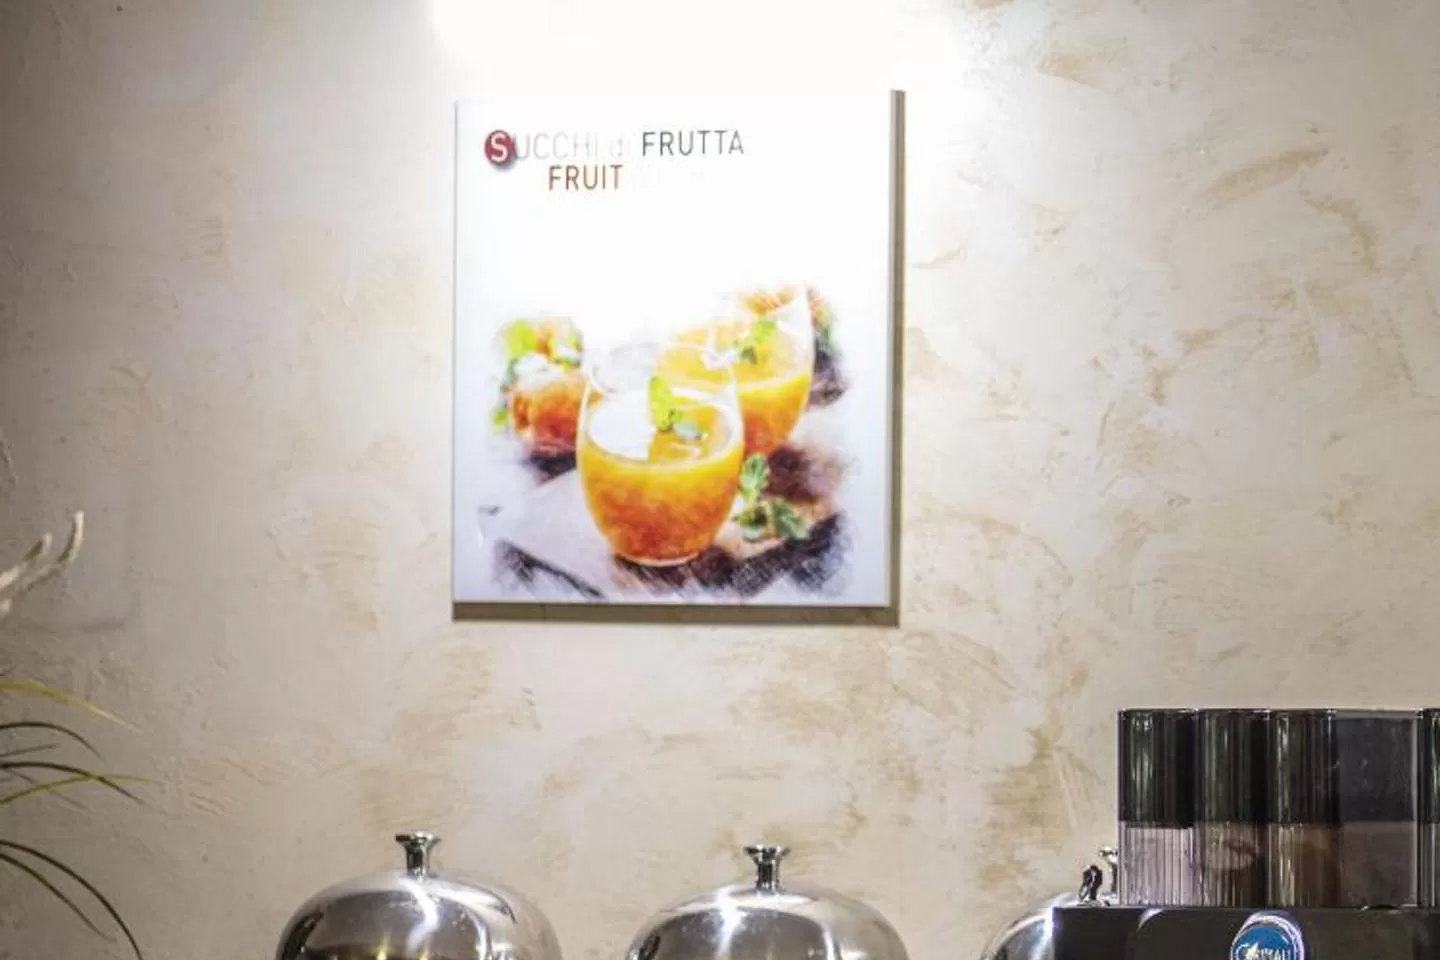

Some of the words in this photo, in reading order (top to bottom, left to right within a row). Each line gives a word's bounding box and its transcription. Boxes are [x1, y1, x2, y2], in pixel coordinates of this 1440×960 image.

[488, 129, 598, 163] SUCCHI
[642, 129, 744, 157] FRUTTA
[548, 163, 624, 191] FRUIT
